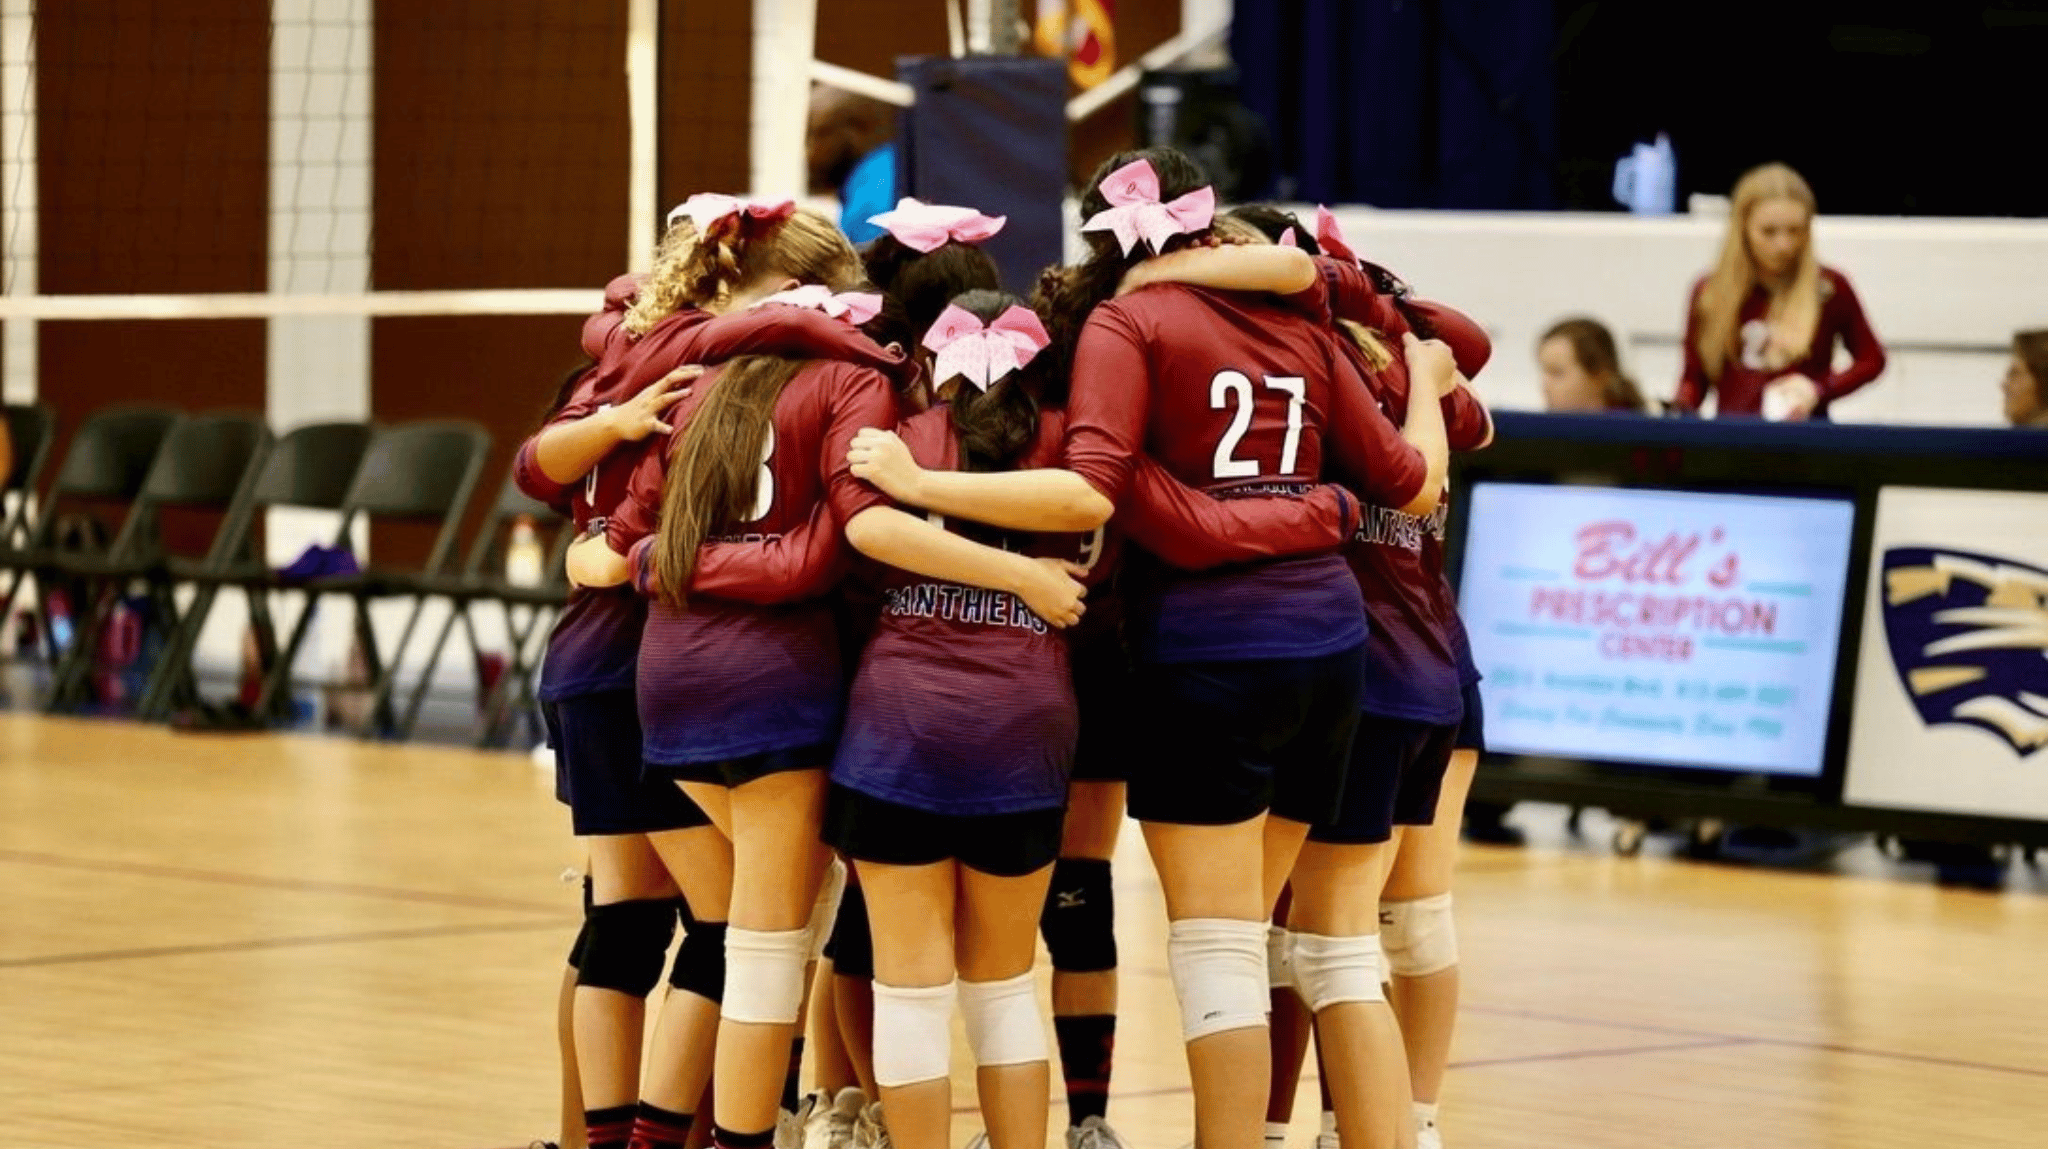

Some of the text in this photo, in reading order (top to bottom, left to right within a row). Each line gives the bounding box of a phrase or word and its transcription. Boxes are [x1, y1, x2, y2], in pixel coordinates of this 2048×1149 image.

[1210, 370, 1306, 479] 27
[1572, 520, 1739, 589] Bill's
[1530, 586, 1778, 636] PRESCRIPTION
[1600, 632, 1694, 662] CENTER
